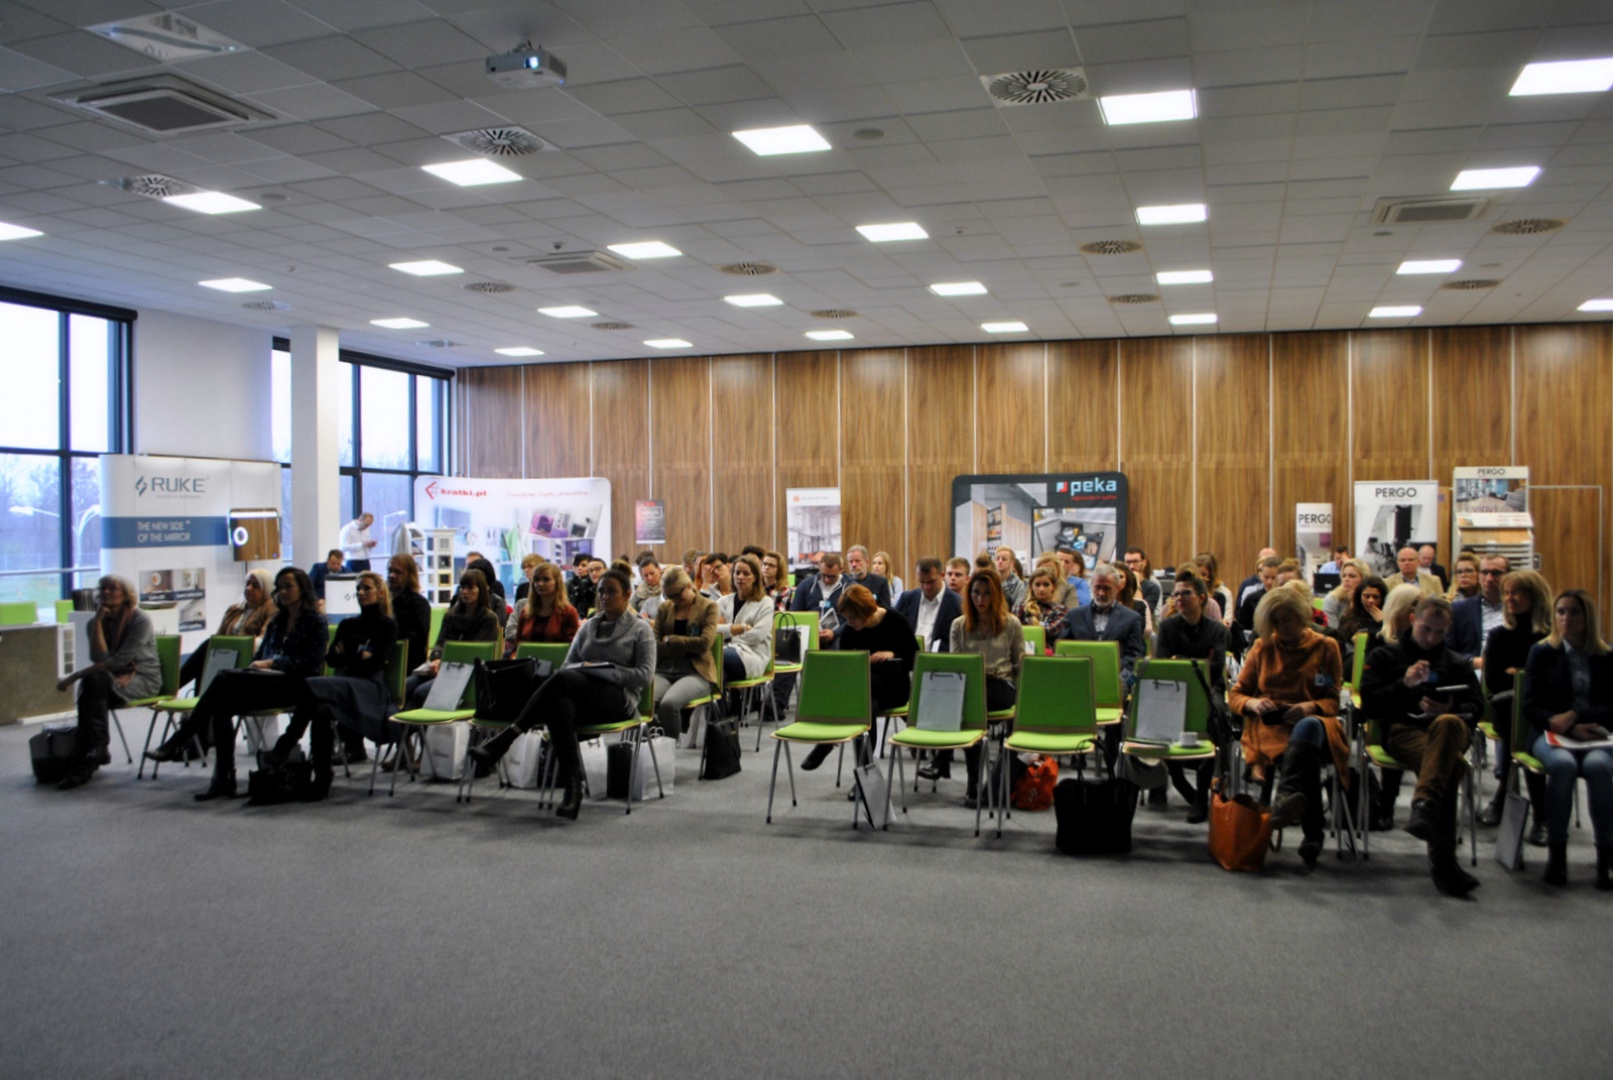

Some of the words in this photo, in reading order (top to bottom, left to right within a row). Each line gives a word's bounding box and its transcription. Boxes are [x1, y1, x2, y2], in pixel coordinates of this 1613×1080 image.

[151, 477, 206, 493] RUKE
[1070, 477, 1117, 496] peka
[441, 488, 487, 497] kratki.pl
[1375, 487, 1417, 498] PERGO
[137, 521, 151, 531] THE
[152, 522, 168, 531] NEW
[170, 521, 185, 531] SIDE
[137, 533, 148, 543] OF
[150, 532, 163, 542] THE
[164, 531, 191, 542] MIRROR
